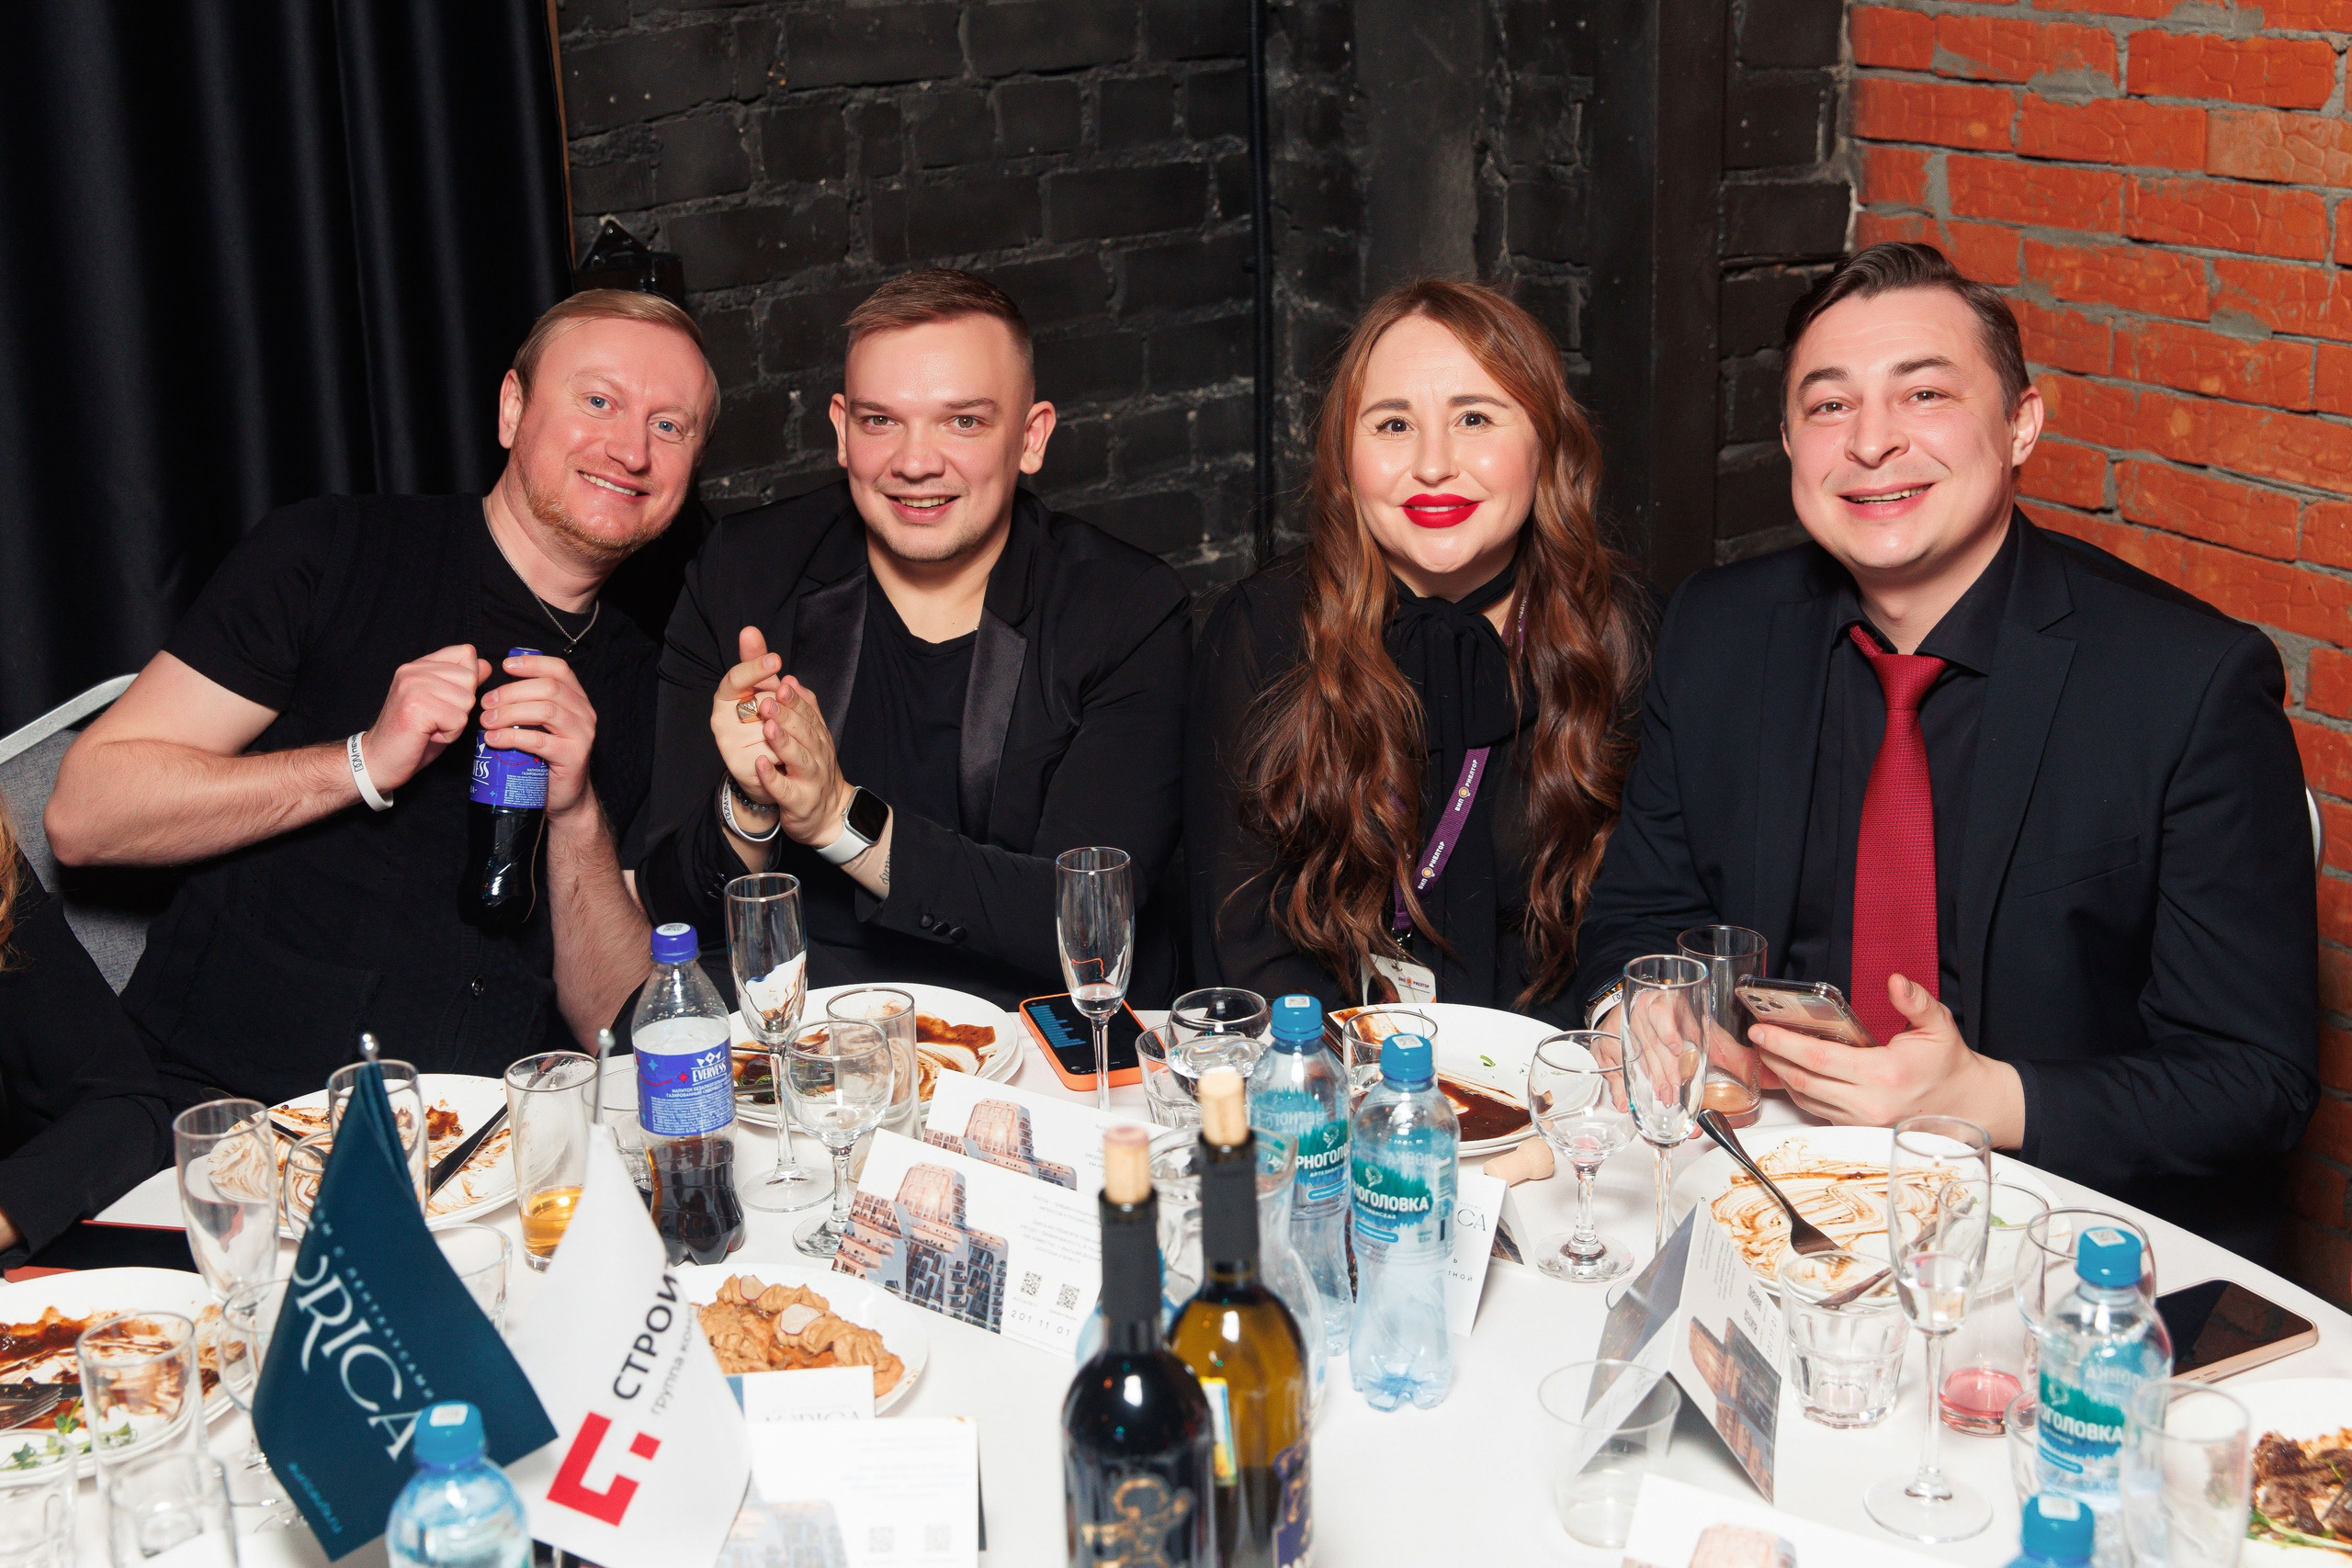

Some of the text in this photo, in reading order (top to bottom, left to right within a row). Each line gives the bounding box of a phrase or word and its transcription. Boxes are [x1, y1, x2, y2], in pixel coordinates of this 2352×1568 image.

[1454, 759, 1478, 812] ВИП РИЕЛТОР
[1418, 840, 1445, 890] ВИП РИЕЛТОР
[692, 1060, 726, 1083] EVERVESS
[1011, 1309, 1070, 1337] 201 11 01
